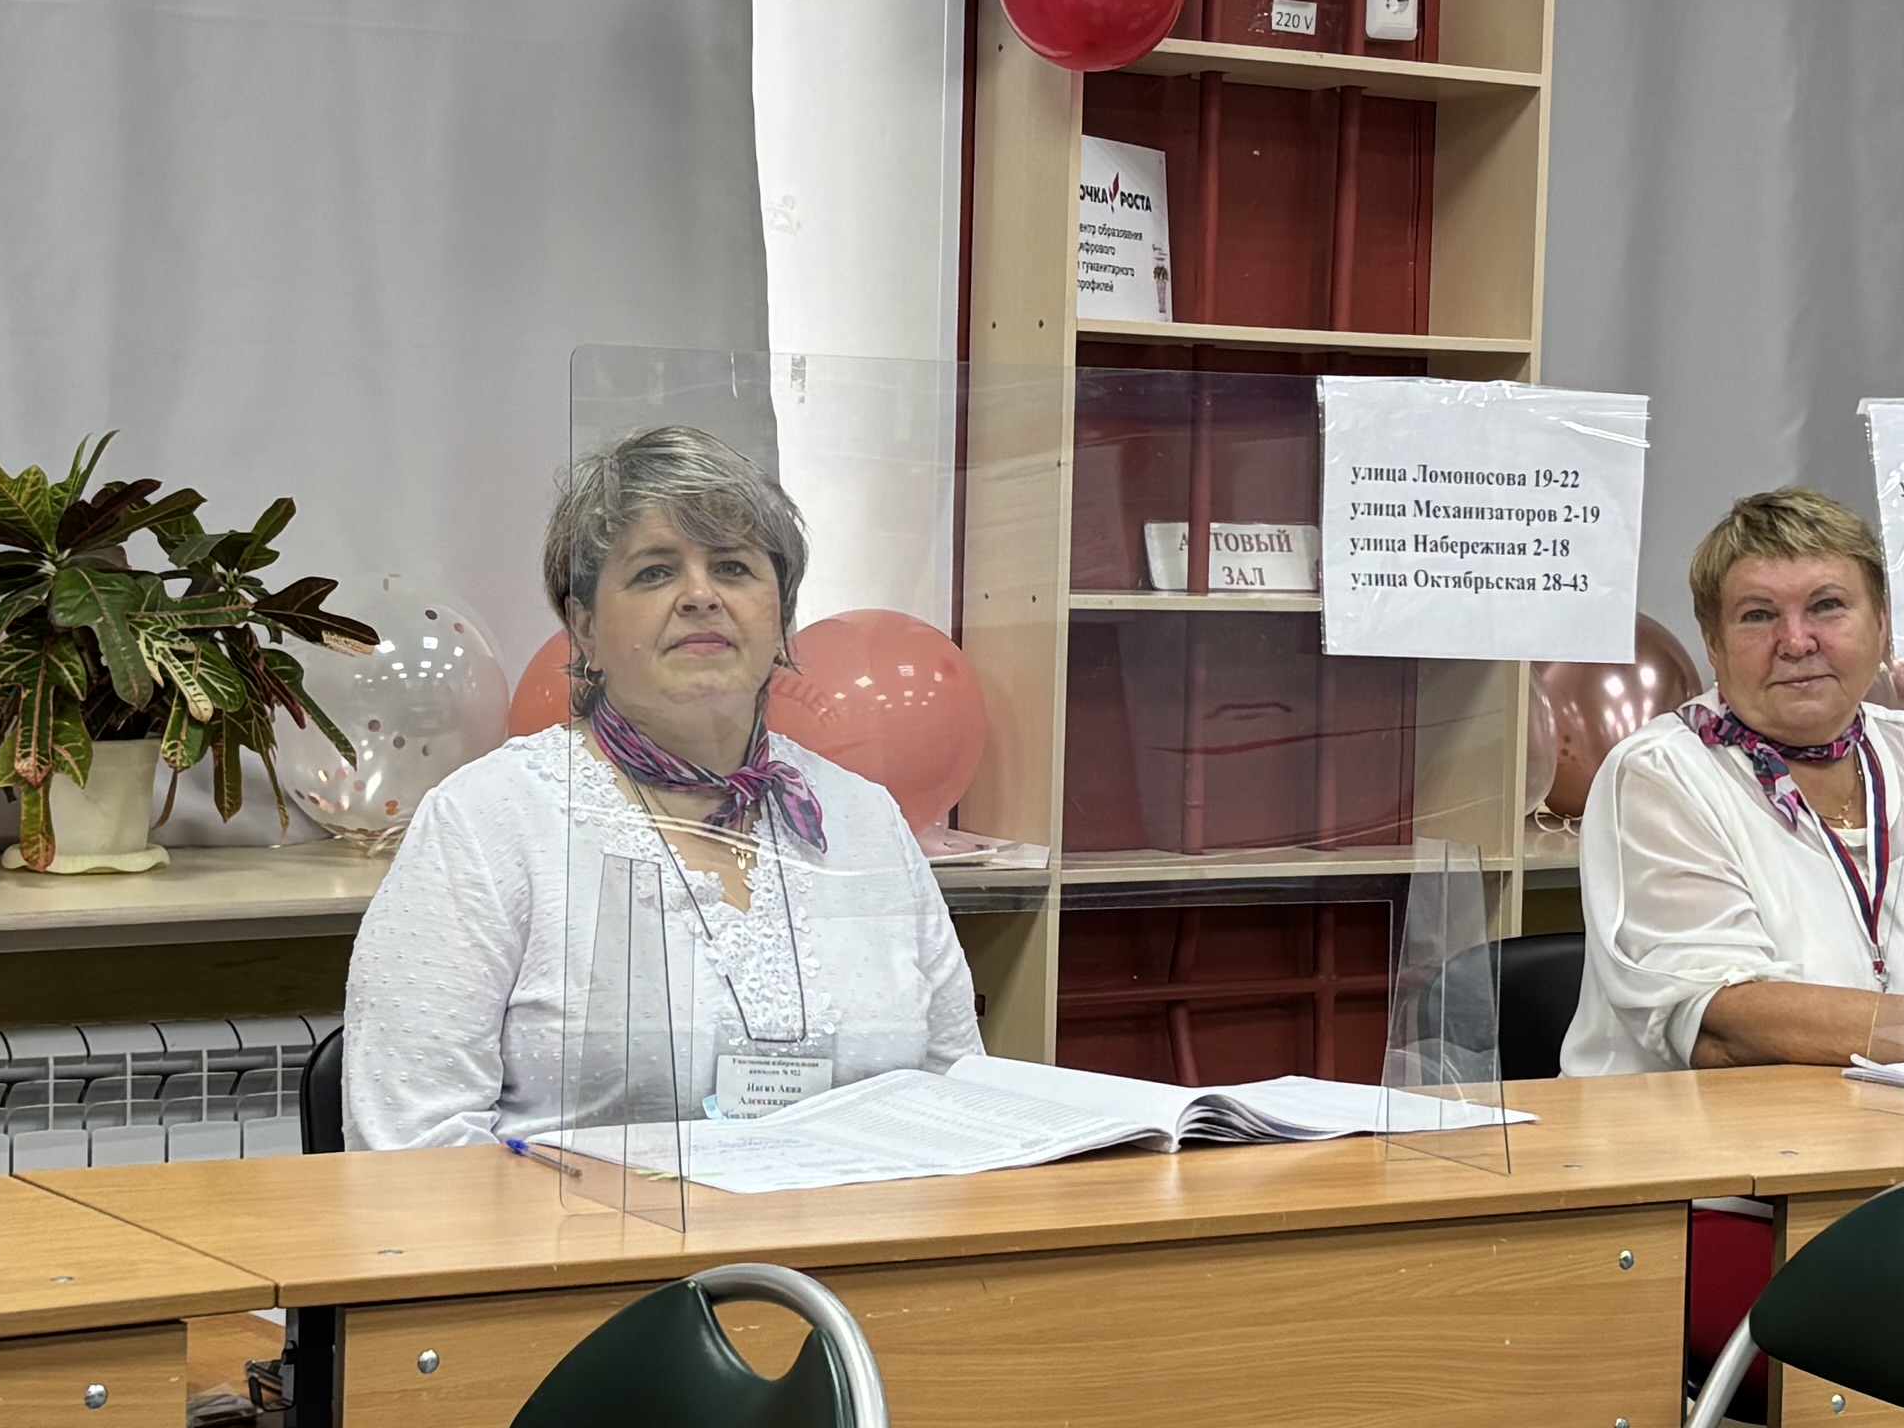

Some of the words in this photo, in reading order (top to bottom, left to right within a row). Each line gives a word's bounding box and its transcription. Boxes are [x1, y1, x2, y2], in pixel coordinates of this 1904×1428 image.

[1275, 11, 1301, 29] 220
[1304, 15, 1314, 30] V
[1120, 190, 1152, 212] РОСТА
[1351, 465, 1407, 486] улица
[1412, 465, 1527, 487] Ломоносова
[1532, 469, 1580, 489] 19-22
[1350, 500, 1407, 521] улица
[1412, 499, 1558, 524] Механизаторов
[1562, 504, 1600, 525] 2-19
[1179, 530, 1293, 553] АТОВЫЙ
[1350, 536, 1407, 557] улица
[1412, 535, 1527, 560] Набережная
[1532, 539, 1570, 558] 2-18
[1222, 567, 1266, 586] ЗАЛ
[1351, 570, 1407, 592] улица
[1413, 569, 1536, 594] Октябрьская
[1541, 573, 1589, 593] 28-43
